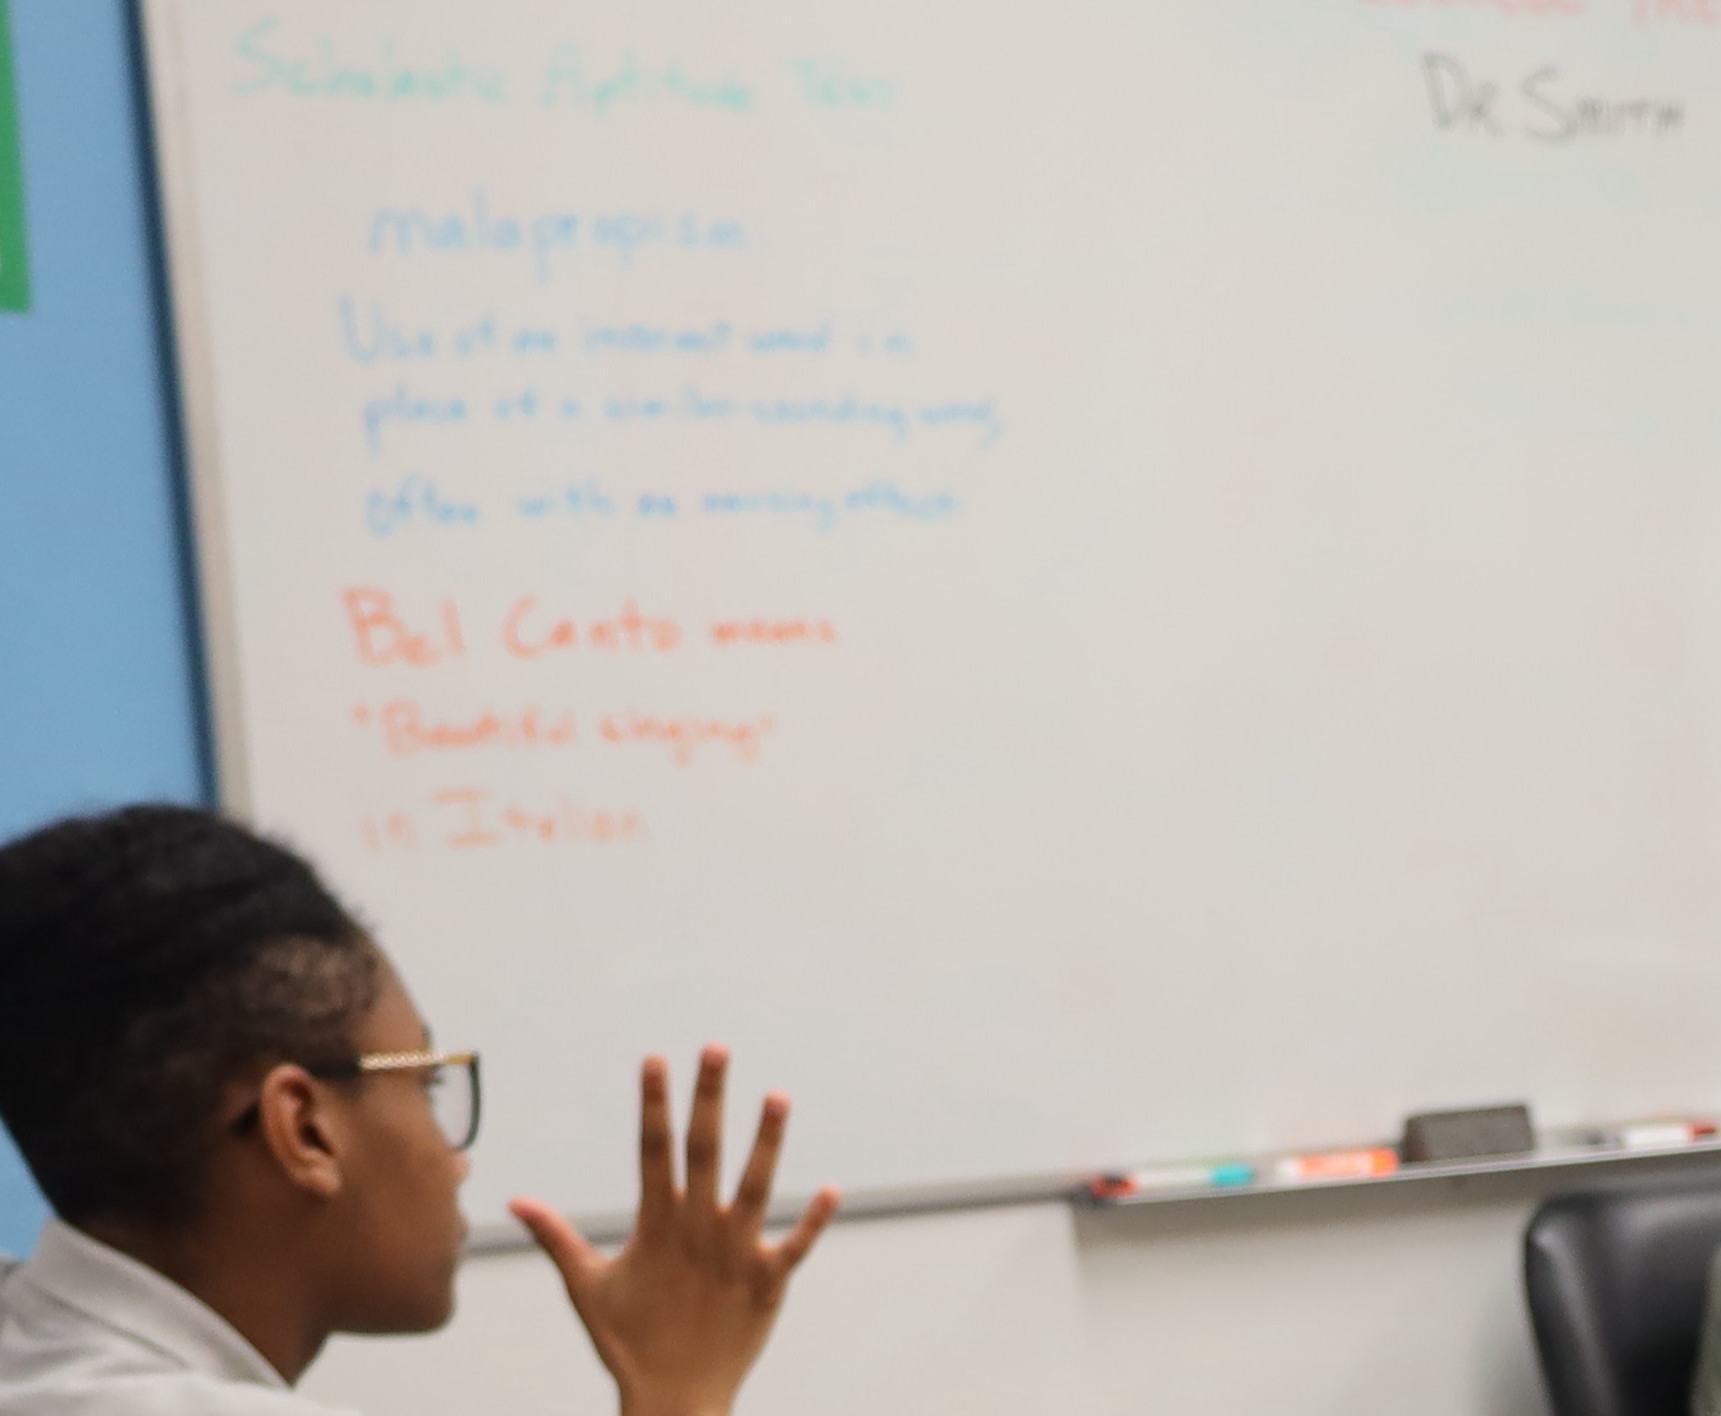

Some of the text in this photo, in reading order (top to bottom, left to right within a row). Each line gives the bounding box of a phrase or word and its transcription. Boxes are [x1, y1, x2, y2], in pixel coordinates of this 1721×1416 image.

[338, 294, 437, 363] Use
[339, 583, 467, 670] Bel
[501, 592, 685, 660] Canto
[360, 807, 421, 854] in
